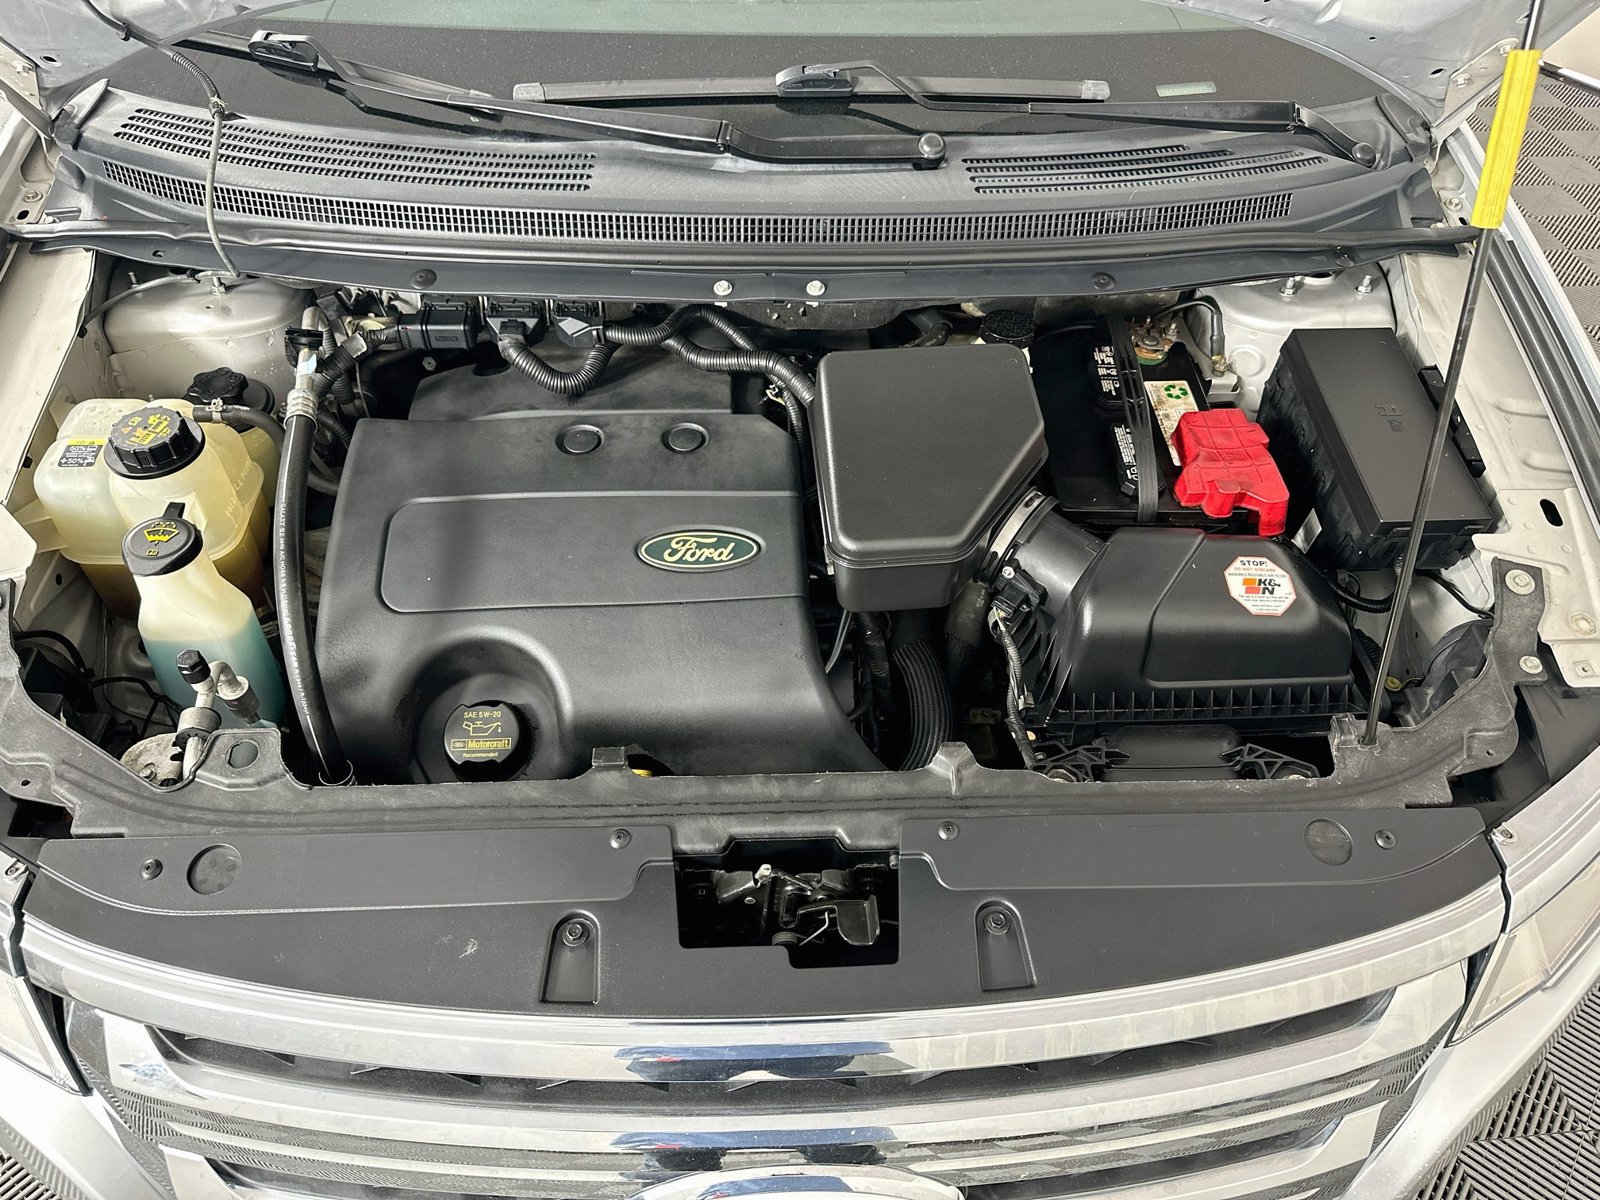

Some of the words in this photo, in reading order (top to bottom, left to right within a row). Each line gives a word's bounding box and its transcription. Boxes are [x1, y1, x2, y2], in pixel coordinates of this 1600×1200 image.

[663, 537, 735, 562] Ford
[279, 503, 287, 526] GALAXY
[285, 617, 299, 668] GOODYEAR
[463, 711, 478, 719] SAE
[479, 711, 502, 719] 5W-20
[467, 739, 509, 749] Motorcraft
[462, 751, 499, 759] Recommended
